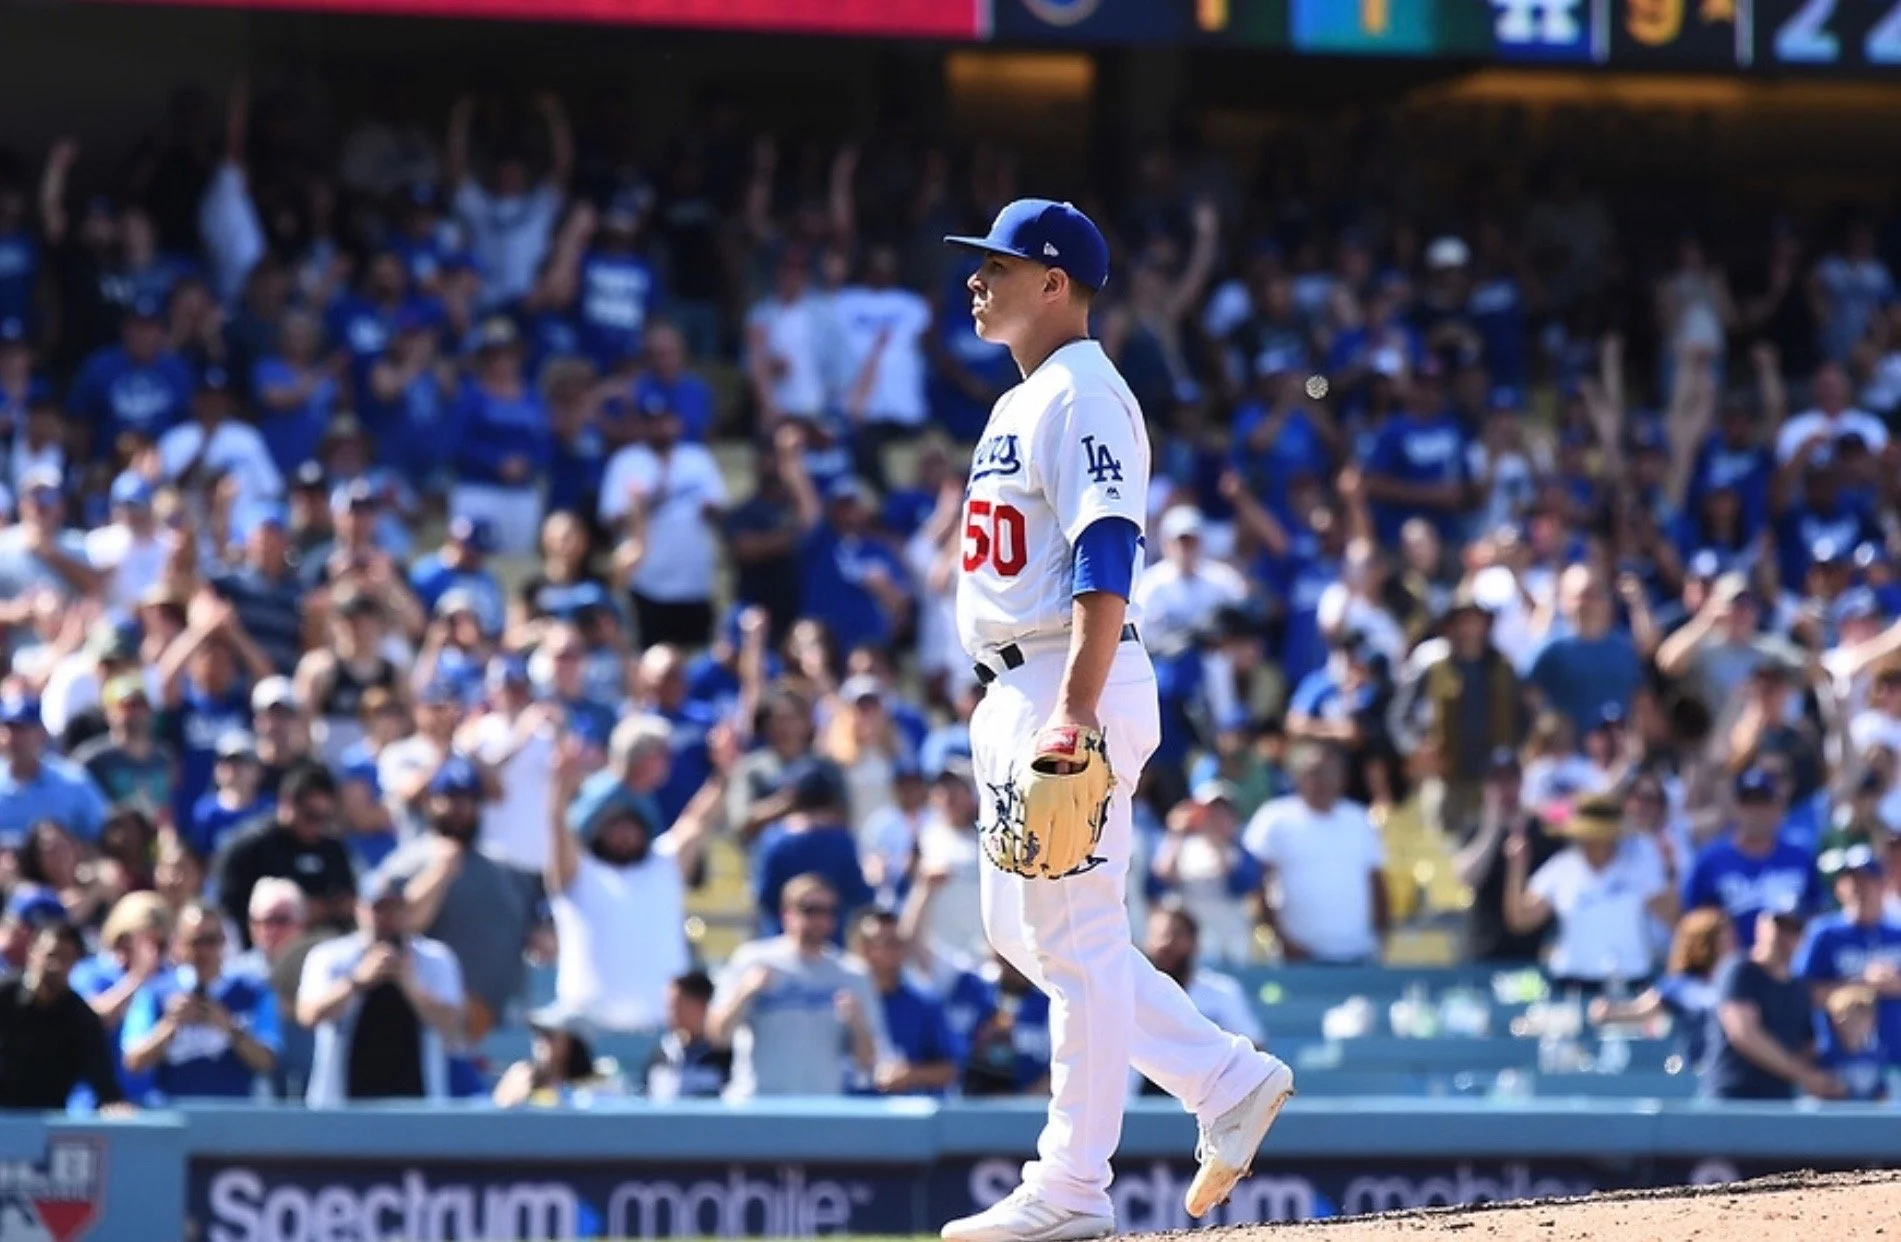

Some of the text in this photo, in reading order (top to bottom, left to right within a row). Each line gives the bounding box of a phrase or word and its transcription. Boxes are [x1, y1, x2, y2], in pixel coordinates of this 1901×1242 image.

[1081, 434, 1124, 483] LA
[963, 500, 1027, 577] 50
[207, 1162, 850, 1242] Spectrum mobile
